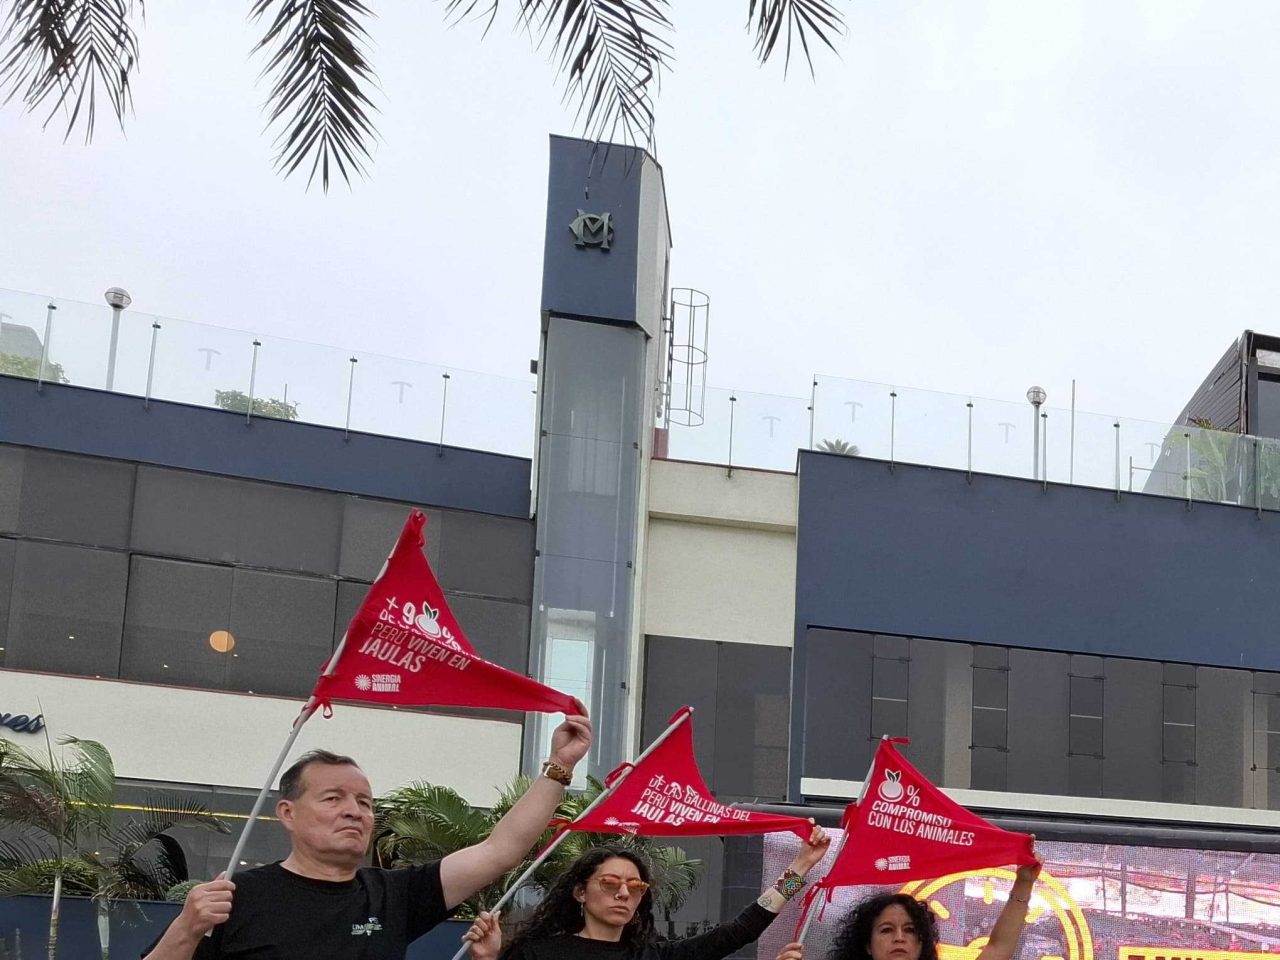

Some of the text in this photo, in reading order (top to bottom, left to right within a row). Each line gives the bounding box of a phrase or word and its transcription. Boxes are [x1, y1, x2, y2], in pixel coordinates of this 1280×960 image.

[358, 637, 426, 673] JAULAS
[371, 621, 408, 645] PERÚ
[408, 636, 450, 662] VIVEN
[447, 654, 471, 671] EN
[642, 788, 671, 810] PERÚ
[670, 800, 704, 822] VIVEN
[649, 776, 666, 791] DE
[684, 792, 732, 817] GALLINAS
[733, 809, 751, 822] DEL
[868, 811, 975, 846] CON LOS ANIMALES
